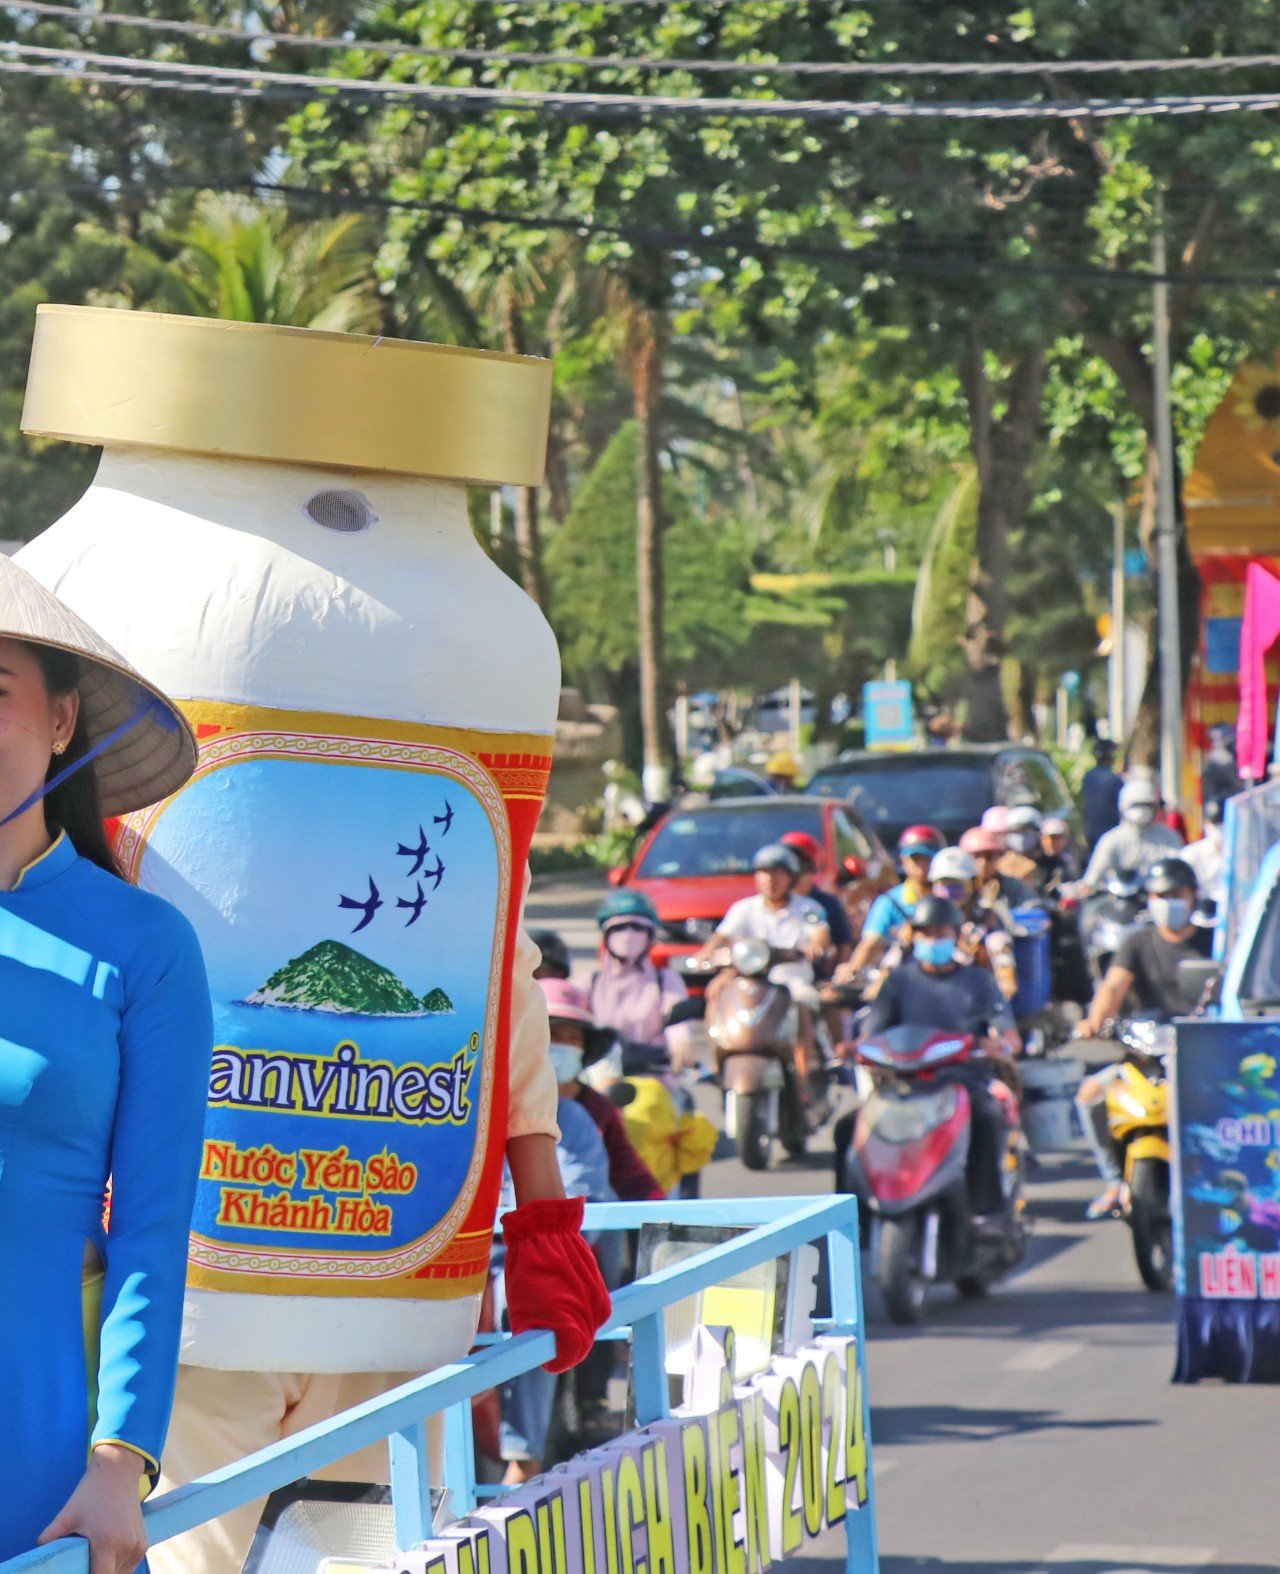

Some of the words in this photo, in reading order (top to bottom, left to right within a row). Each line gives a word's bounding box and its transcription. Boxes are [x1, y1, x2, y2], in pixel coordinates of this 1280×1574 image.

[201, 1143, 295, 1185] Nước
[301, 1146, 362, 1190] Yến
[366, 1150, 417, 1193] Sào
[218, 1188, 332, 1231] Khánh
[335, 1197, 392, 1235] Hòa
[1201, 1243, 1256, 1298] LIÊN
[778, 1344, 869, 1558] 2024
